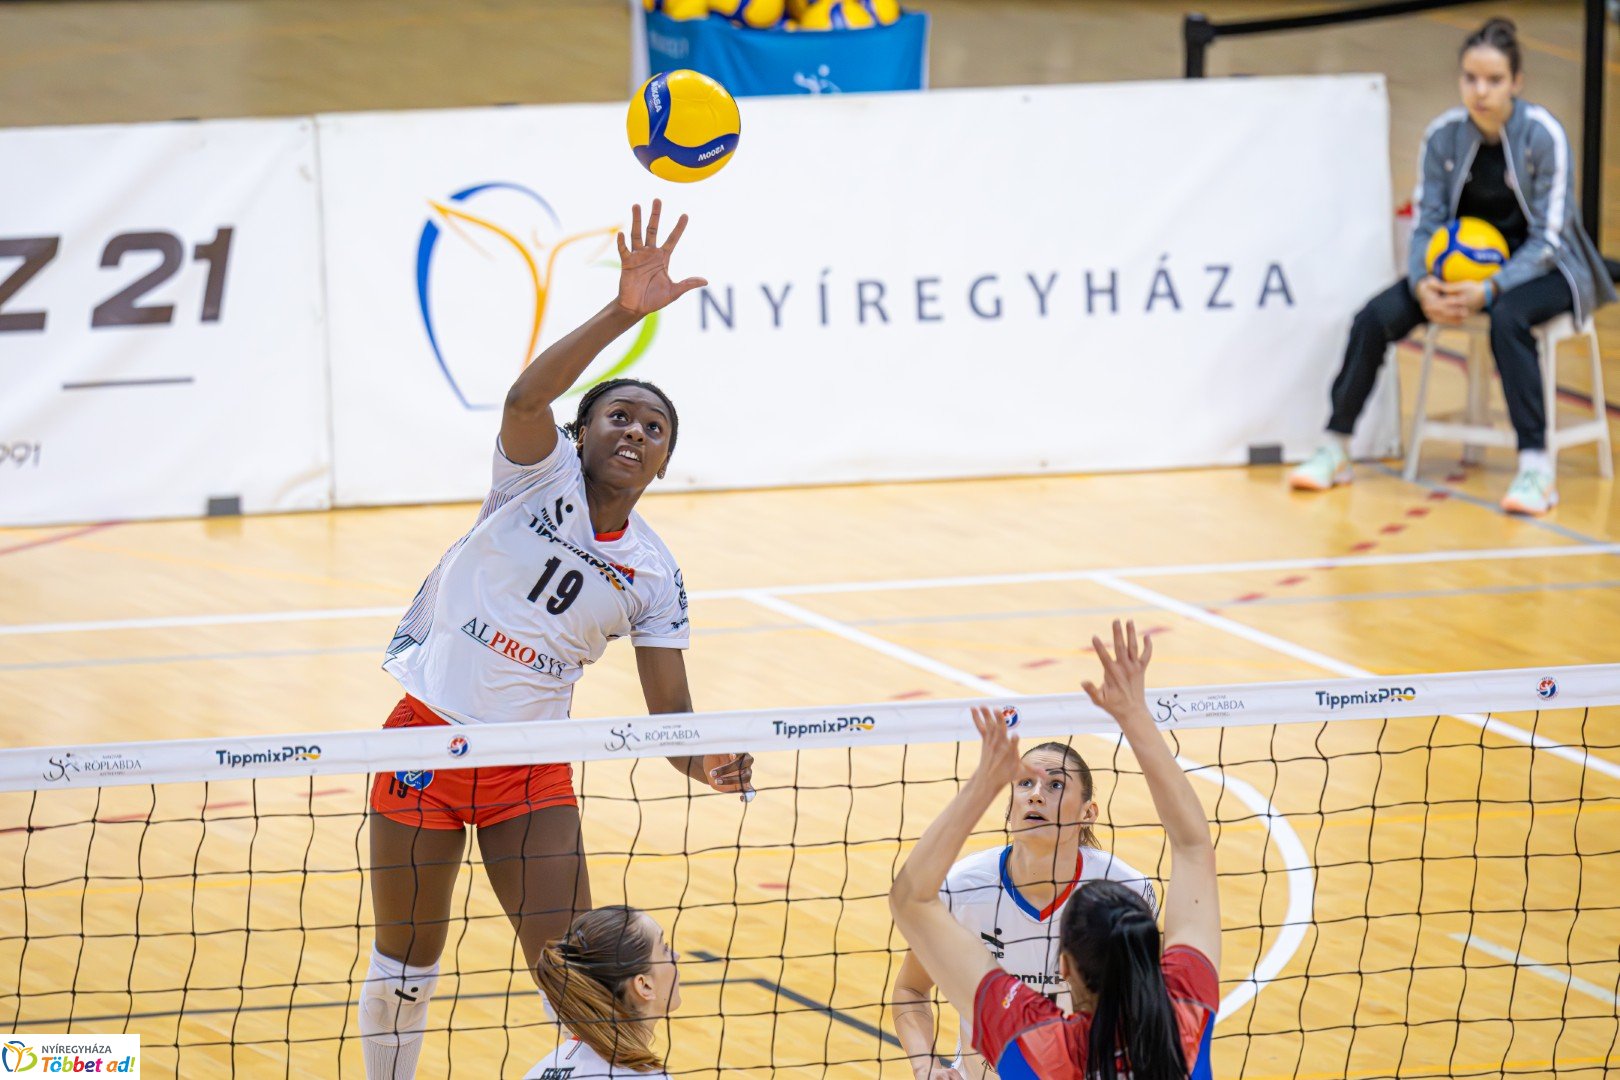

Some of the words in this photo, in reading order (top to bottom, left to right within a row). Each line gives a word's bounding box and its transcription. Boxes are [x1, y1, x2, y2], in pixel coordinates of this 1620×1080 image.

[650, 80, 663, 113] MIKASA
[698, 144, 725, 162] V200W
[91, 227, 235, 329] 21
[699, 254, 1297, 333] NYÍREGYHÁZA
[527, 556, 584, 615] 19
[461, 617, 567, 679] ALPROSYS
[1191, 700, 1245, 712] RÖPLABDA
[1315, 687, 1416, 710] TippmixPRO
[645, 729, 701, 741] RÖPLABDA
[772, 716, 876, 739] TippmixPRO
[84, 759, 142, 772] RÖPLABDA
[216, 745, 322, 768] TippmixPRO
